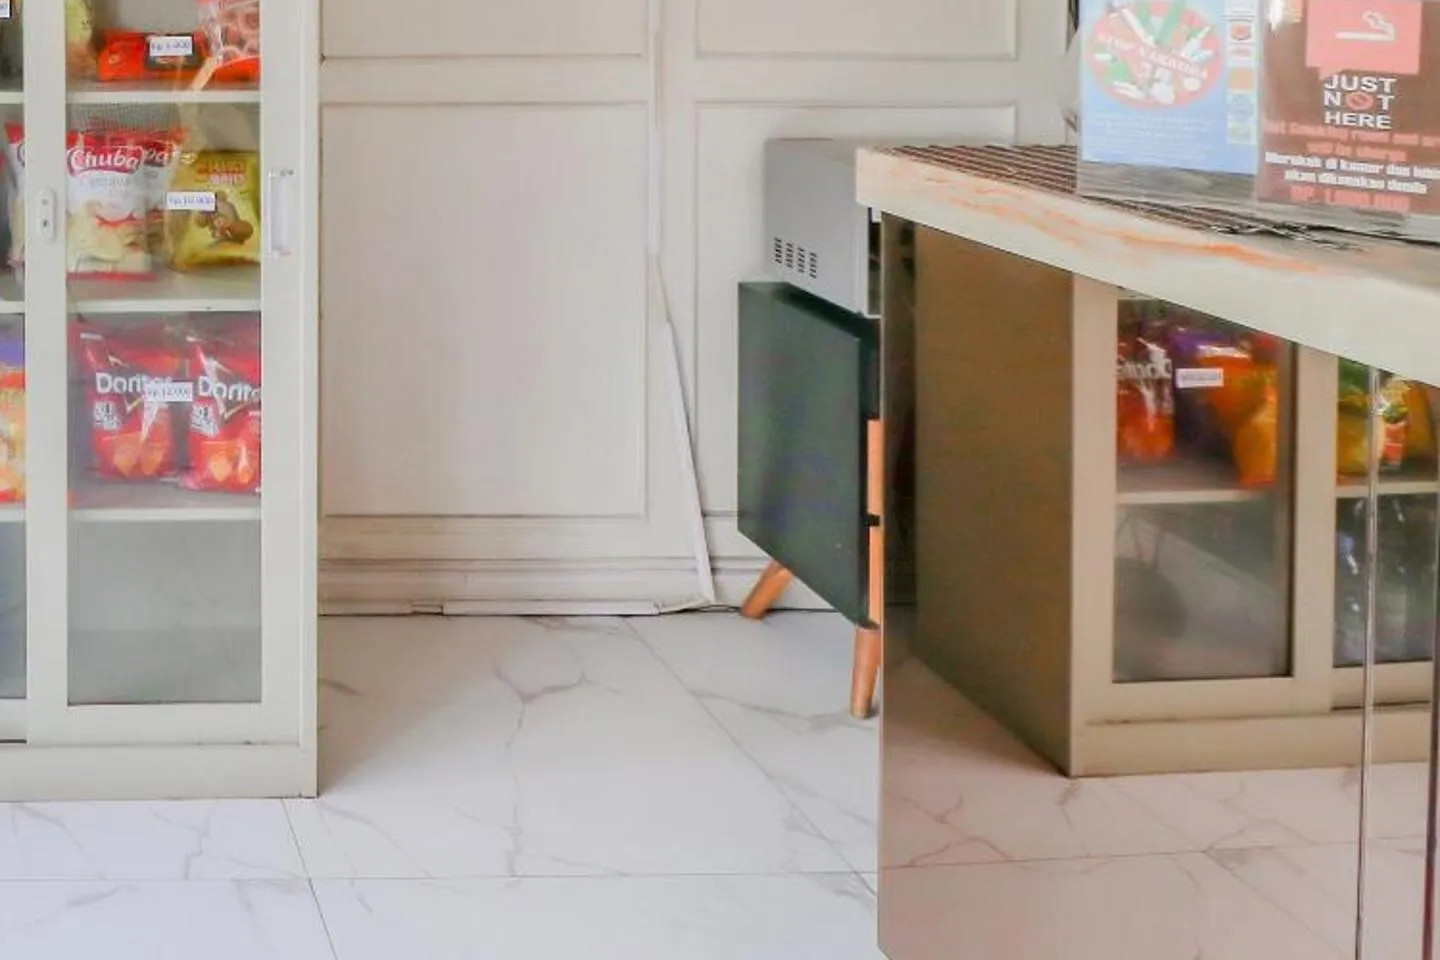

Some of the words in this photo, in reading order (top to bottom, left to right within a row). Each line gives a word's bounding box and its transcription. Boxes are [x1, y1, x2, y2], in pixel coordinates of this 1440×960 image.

[1323, 74, 1397, 92] JUST
[1324, 90, 1395, 111] NOT
[1324, 111, 1393, 129] HERE
[70, 146, 139, 172] Chuba
